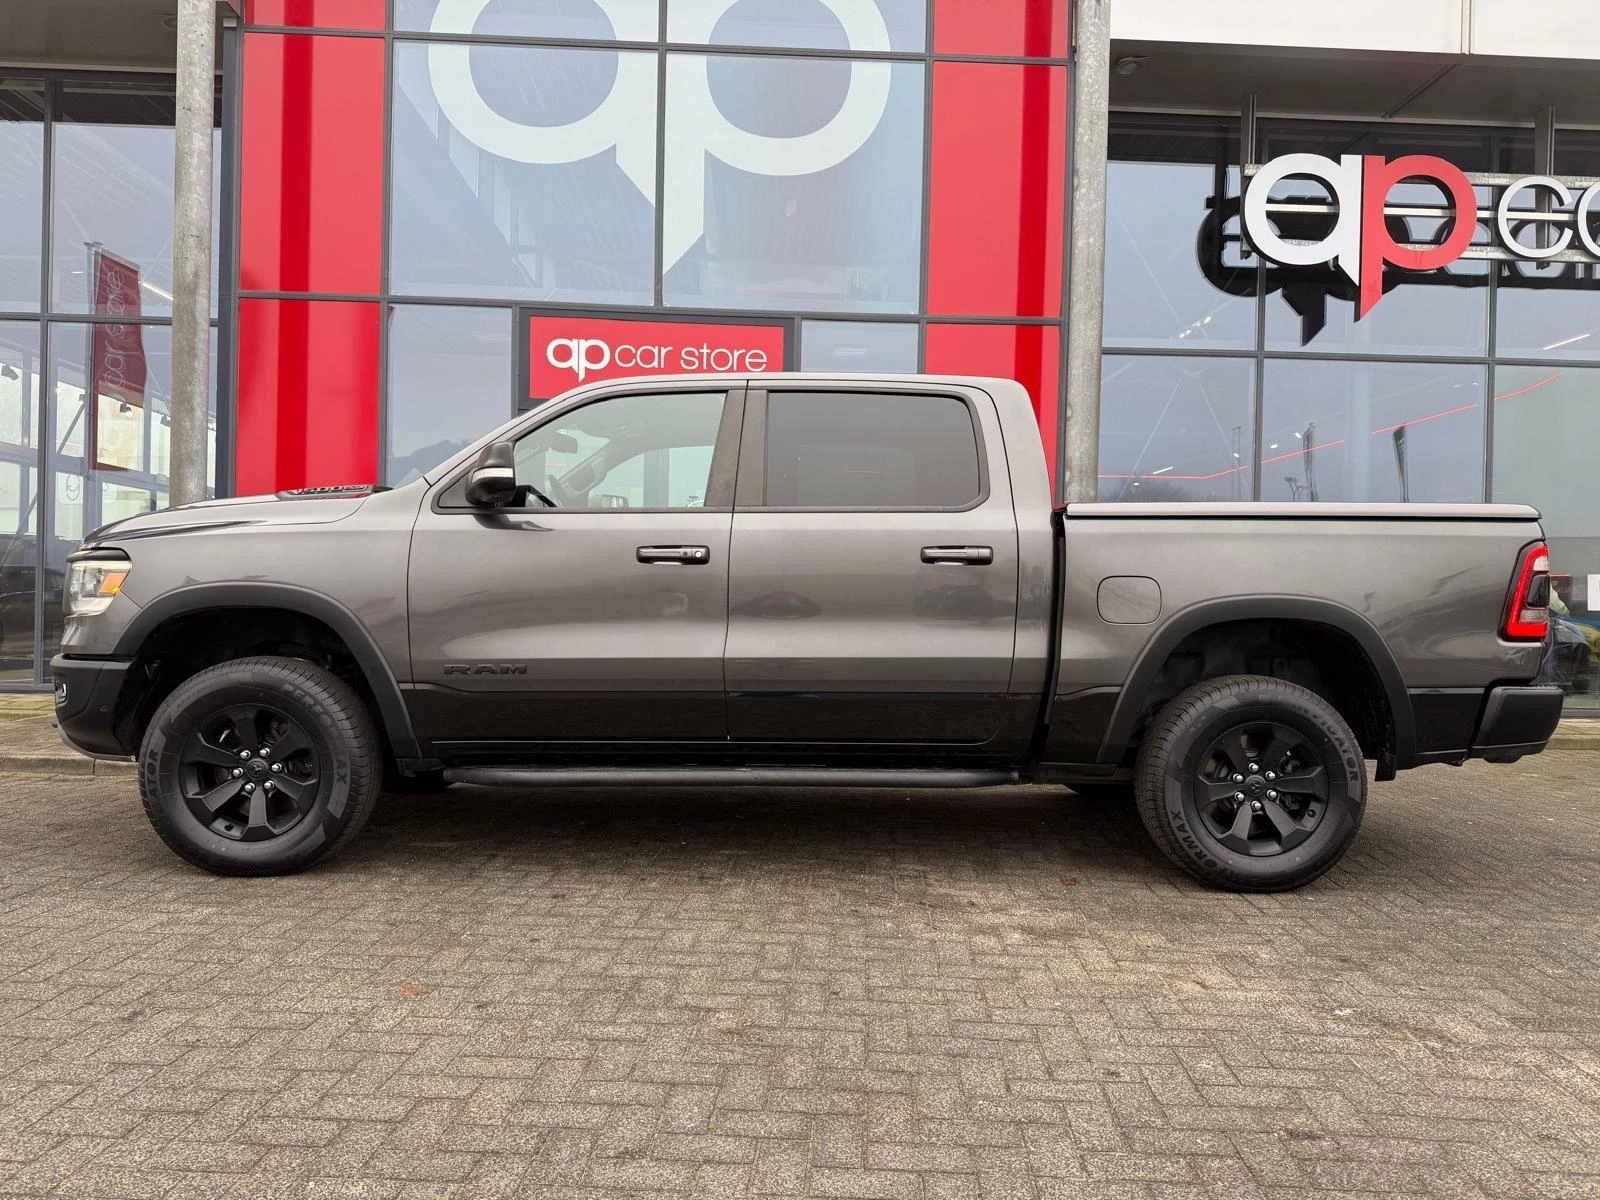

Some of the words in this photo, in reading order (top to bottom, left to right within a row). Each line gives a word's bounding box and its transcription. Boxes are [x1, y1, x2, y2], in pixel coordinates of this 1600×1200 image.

[1498, 176, 1600, 258] c
[105, 268, 127, 339] sore
[615, 344, 673, 369] car
[680, 342, 767, 372] store
[444, 663, 527, 675] RAM
